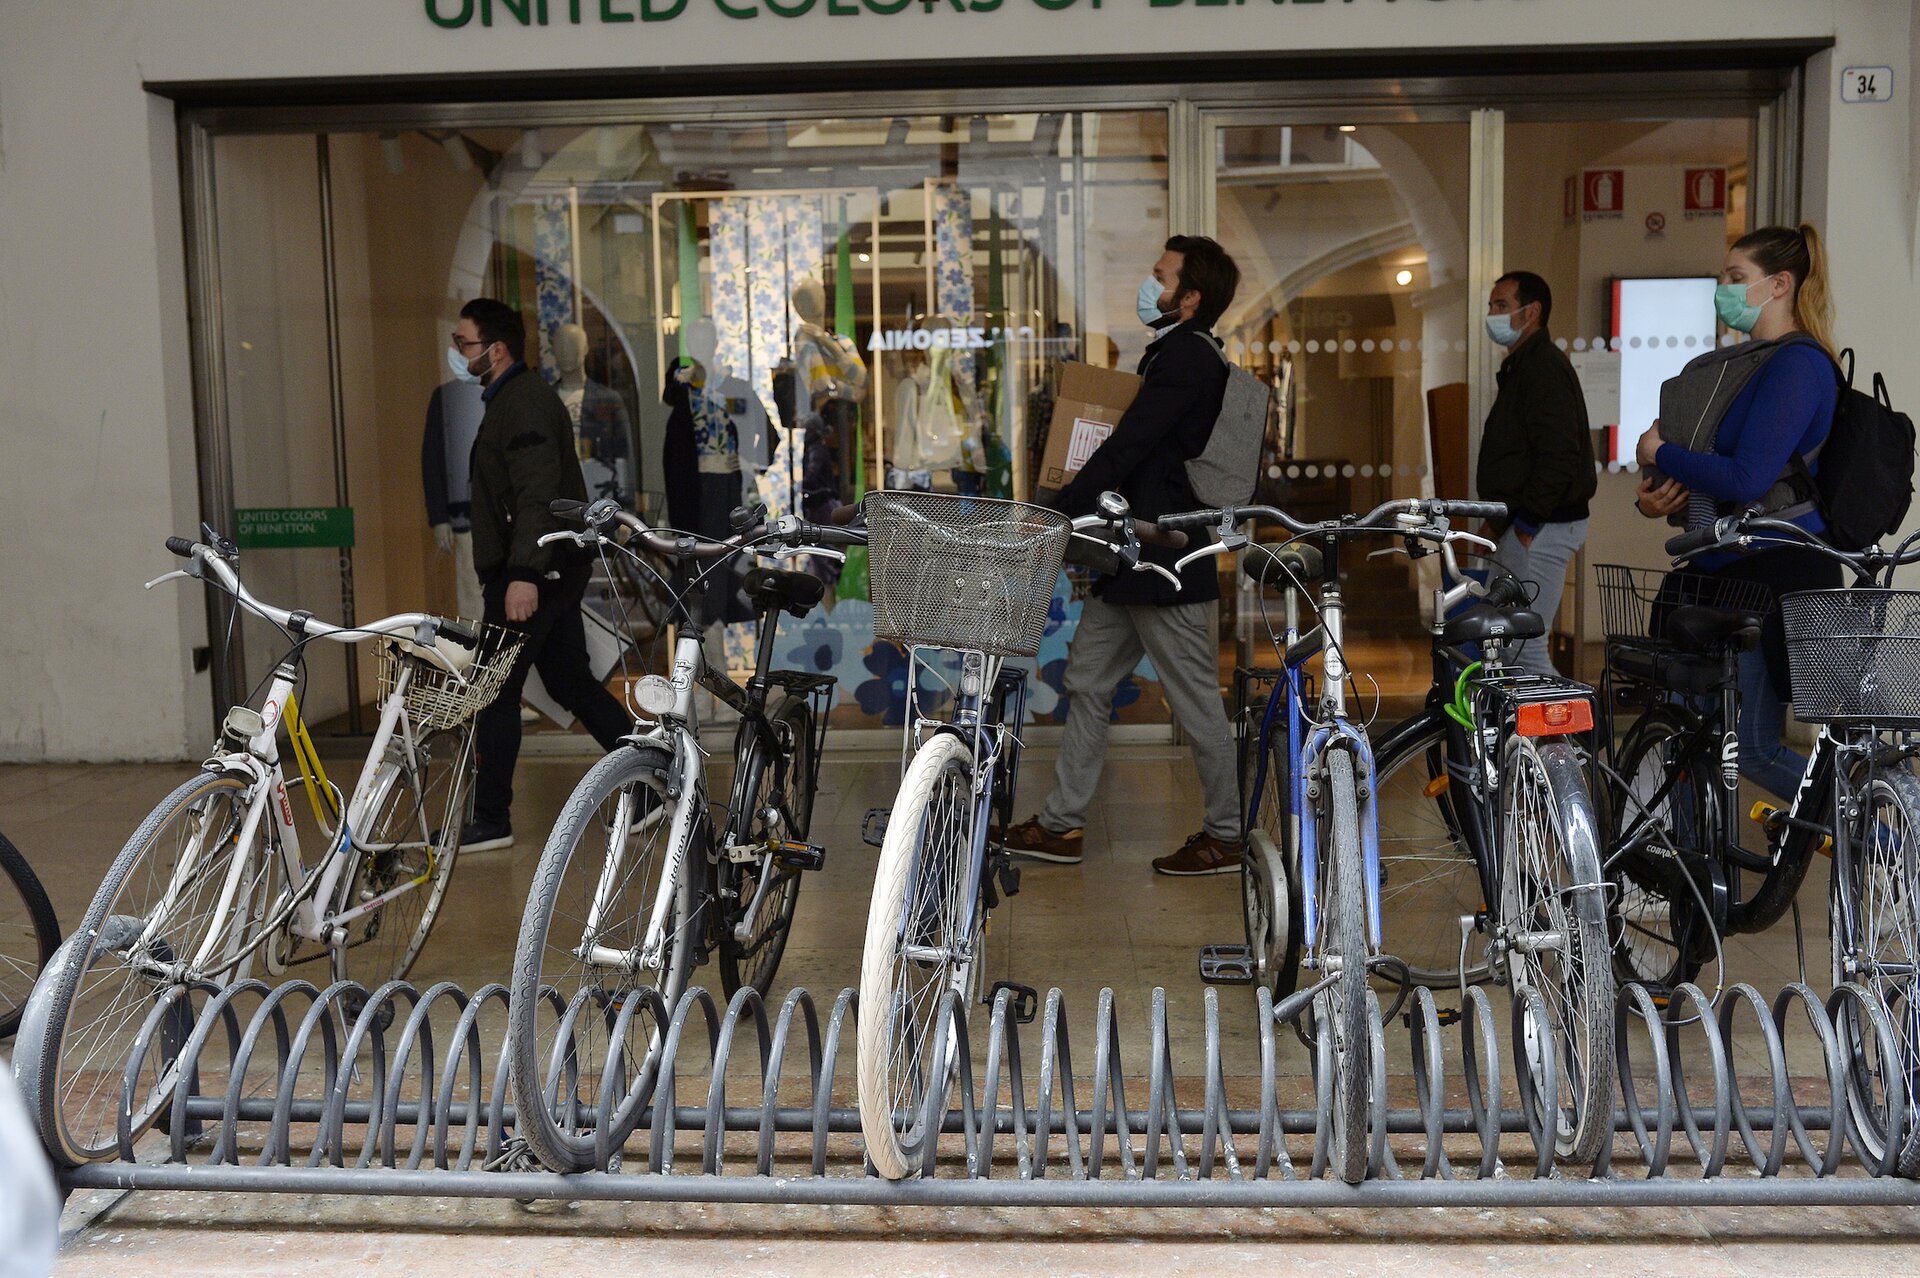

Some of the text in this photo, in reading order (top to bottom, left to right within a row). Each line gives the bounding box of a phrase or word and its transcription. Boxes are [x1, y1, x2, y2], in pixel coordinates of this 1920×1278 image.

[1857, 74, 1876, 94] 34
[238, 510, 327, 522] UNITED COLORS
[238, 524, 254, 534] OF
[669, 833, 686, 886] italian
